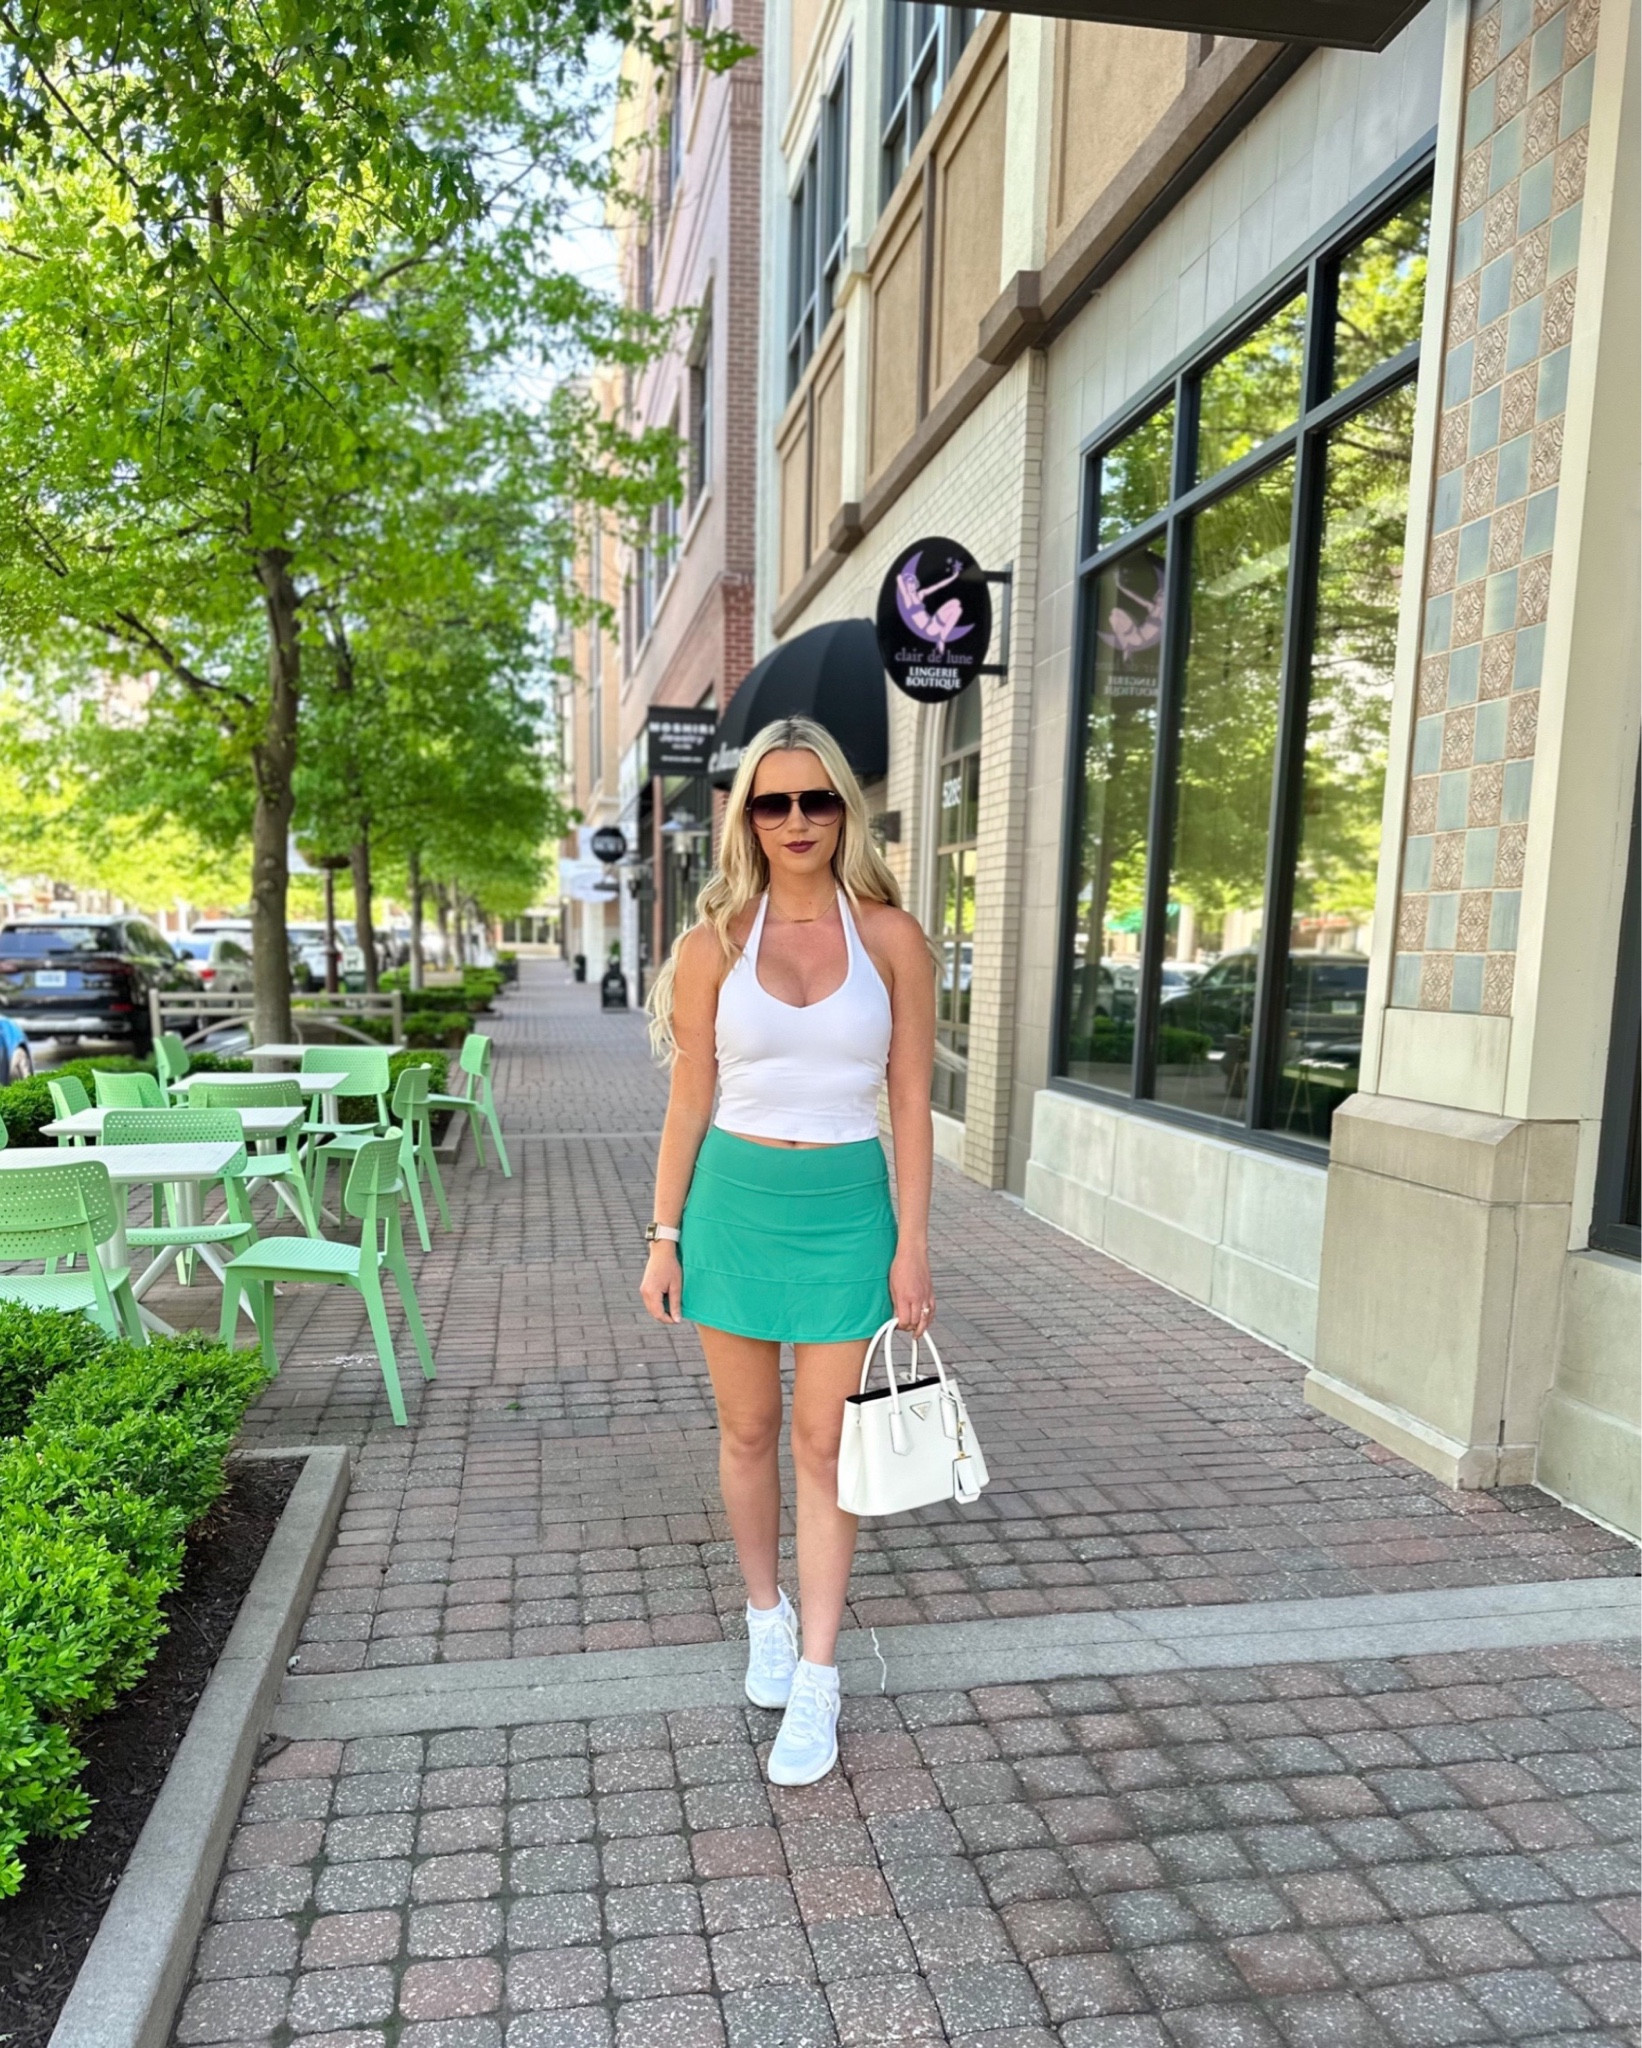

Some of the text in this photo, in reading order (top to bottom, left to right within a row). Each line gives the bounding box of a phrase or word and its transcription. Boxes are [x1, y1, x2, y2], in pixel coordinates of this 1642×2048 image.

[895, 647, 974, 665] clair de lune
[909, 666, 959, 678] LINGERIE
[905, 676, 962, 690] BOUTIQUE
